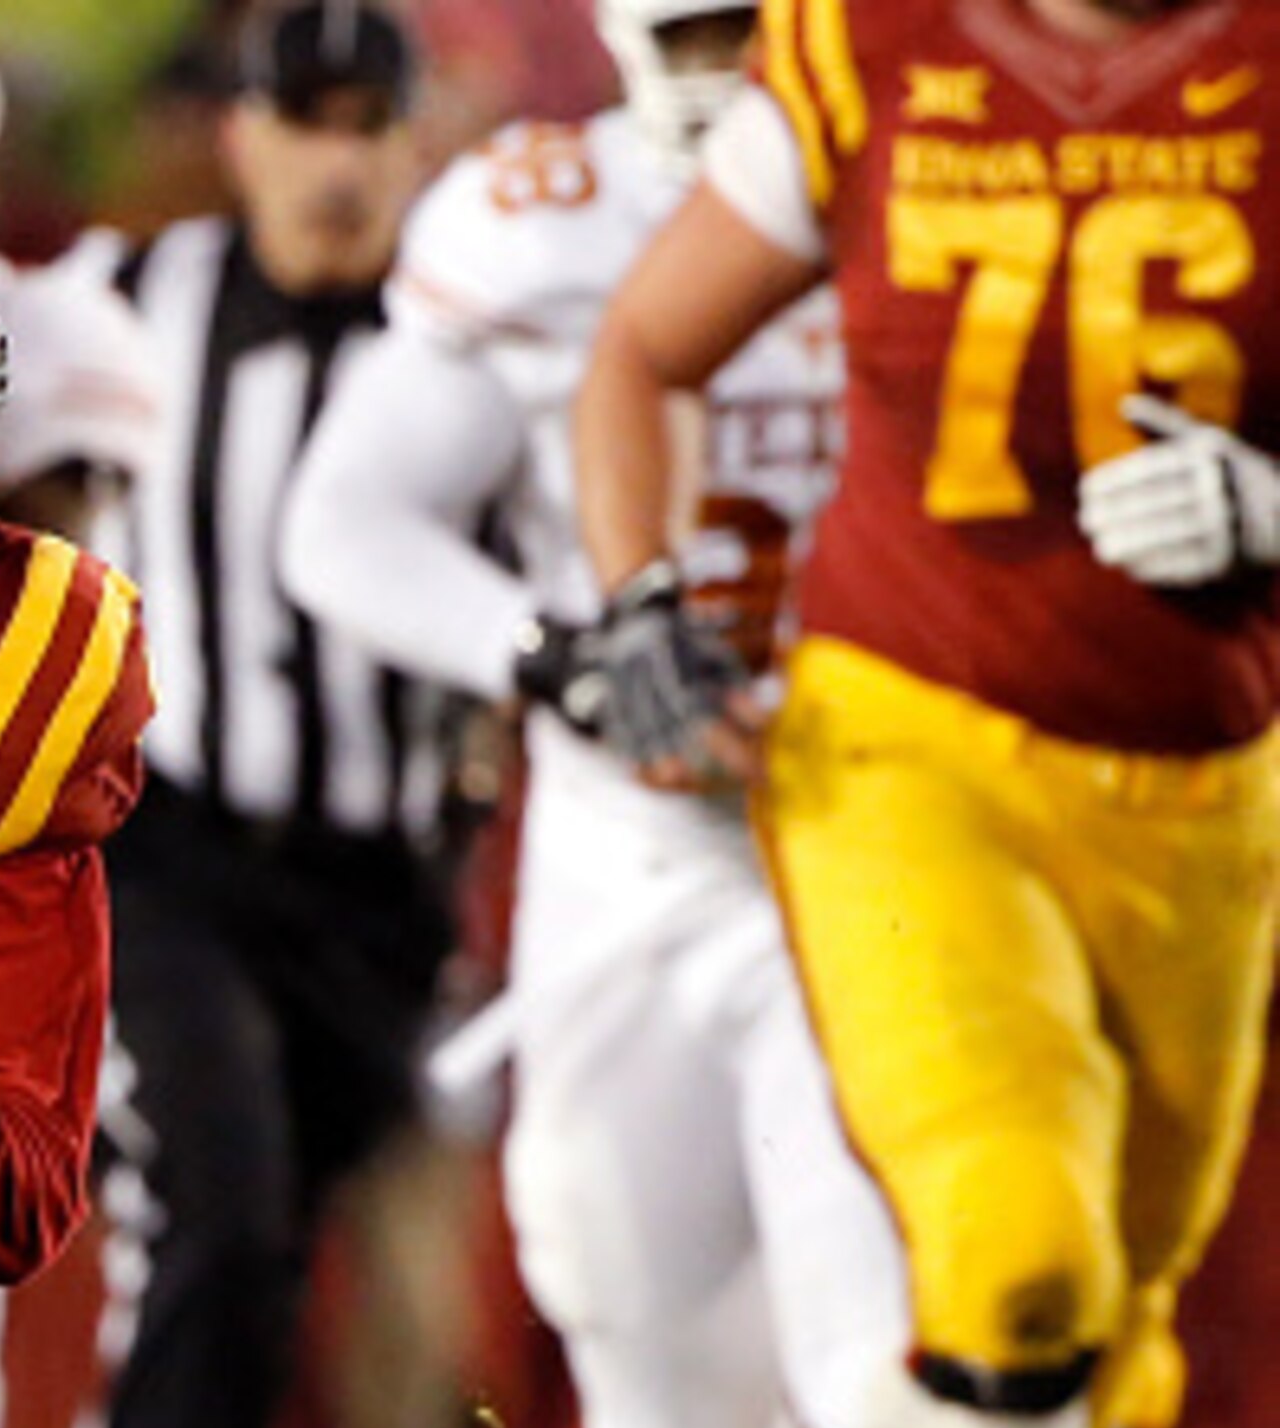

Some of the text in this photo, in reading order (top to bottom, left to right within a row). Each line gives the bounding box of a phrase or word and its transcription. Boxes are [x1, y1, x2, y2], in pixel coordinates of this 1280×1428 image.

[892, 130, 1260, 192] IOWA STATE
[887, 190, 1254, 519] 76
